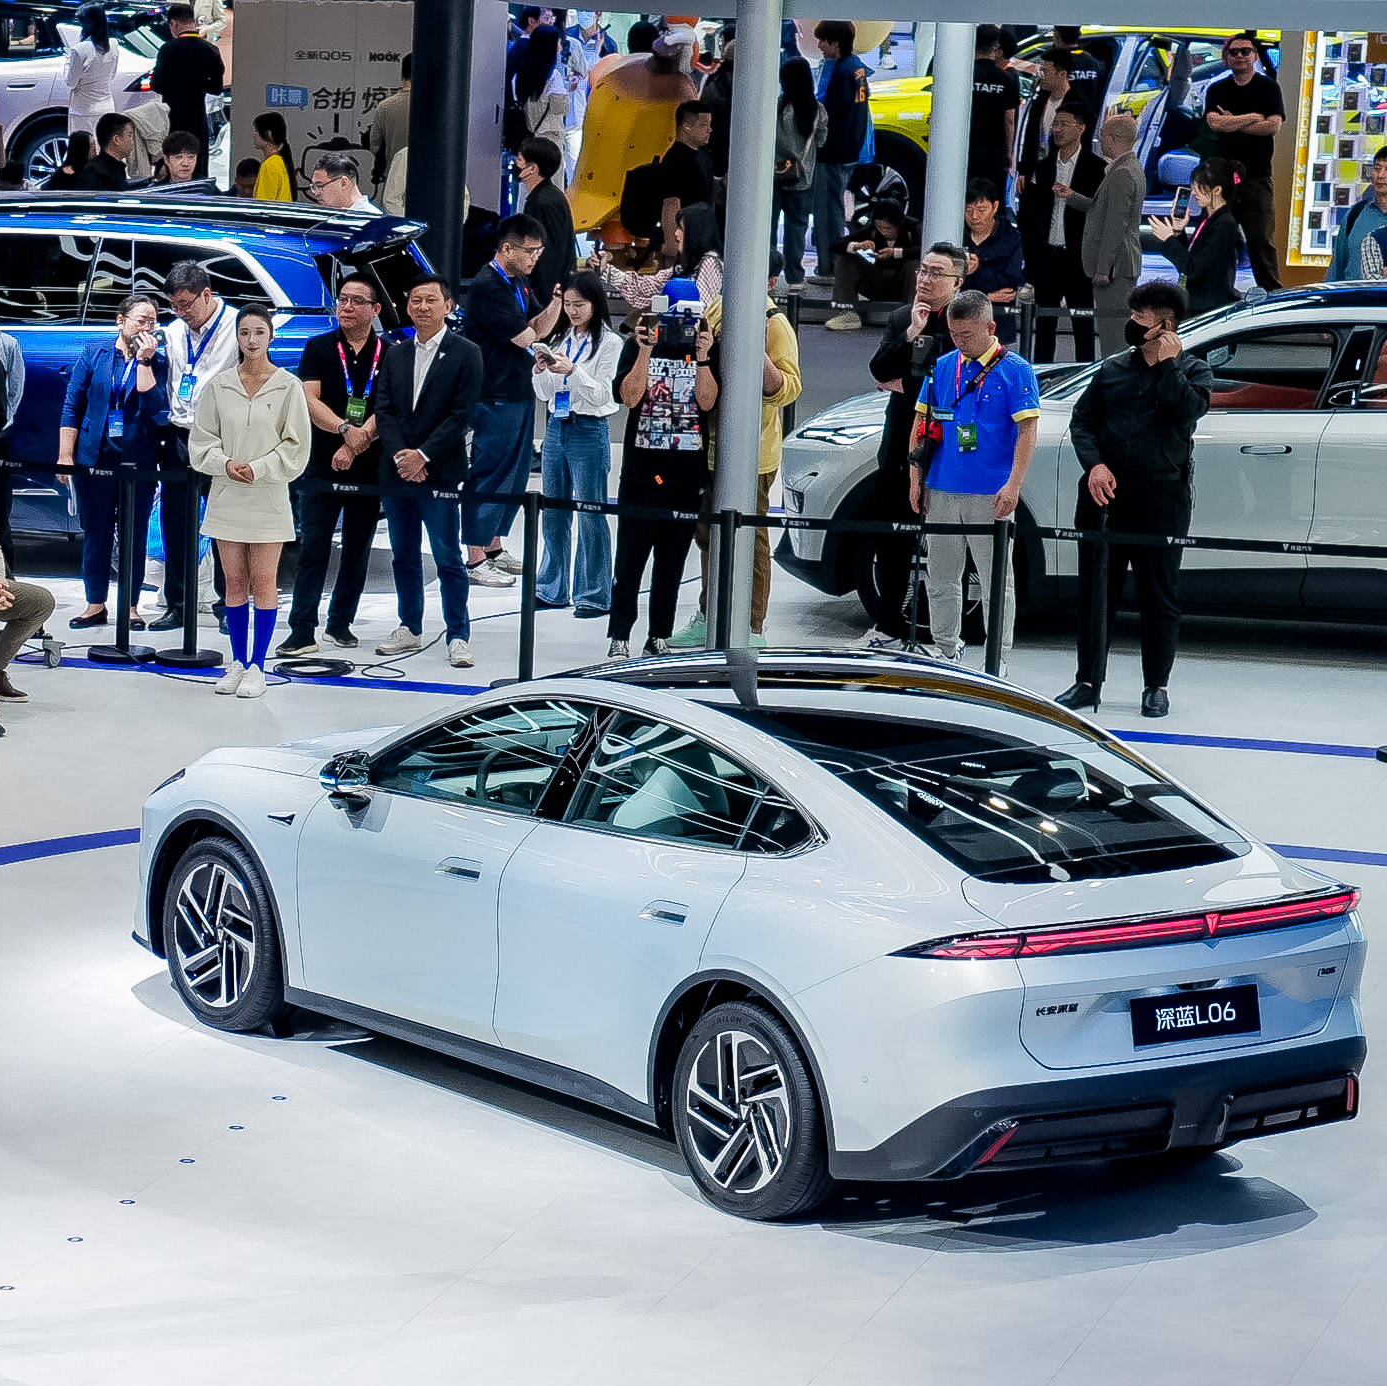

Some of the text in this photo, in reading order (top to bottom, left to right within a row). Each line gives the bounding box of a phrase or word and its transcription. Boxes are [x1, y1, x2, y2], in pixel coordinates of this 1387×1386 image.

[312, 87, 405, 114] 合拍 惊
[971, 83, 1004, 94] TAFF
[1155, 1002, 1236, 1031] 深蓝L06
